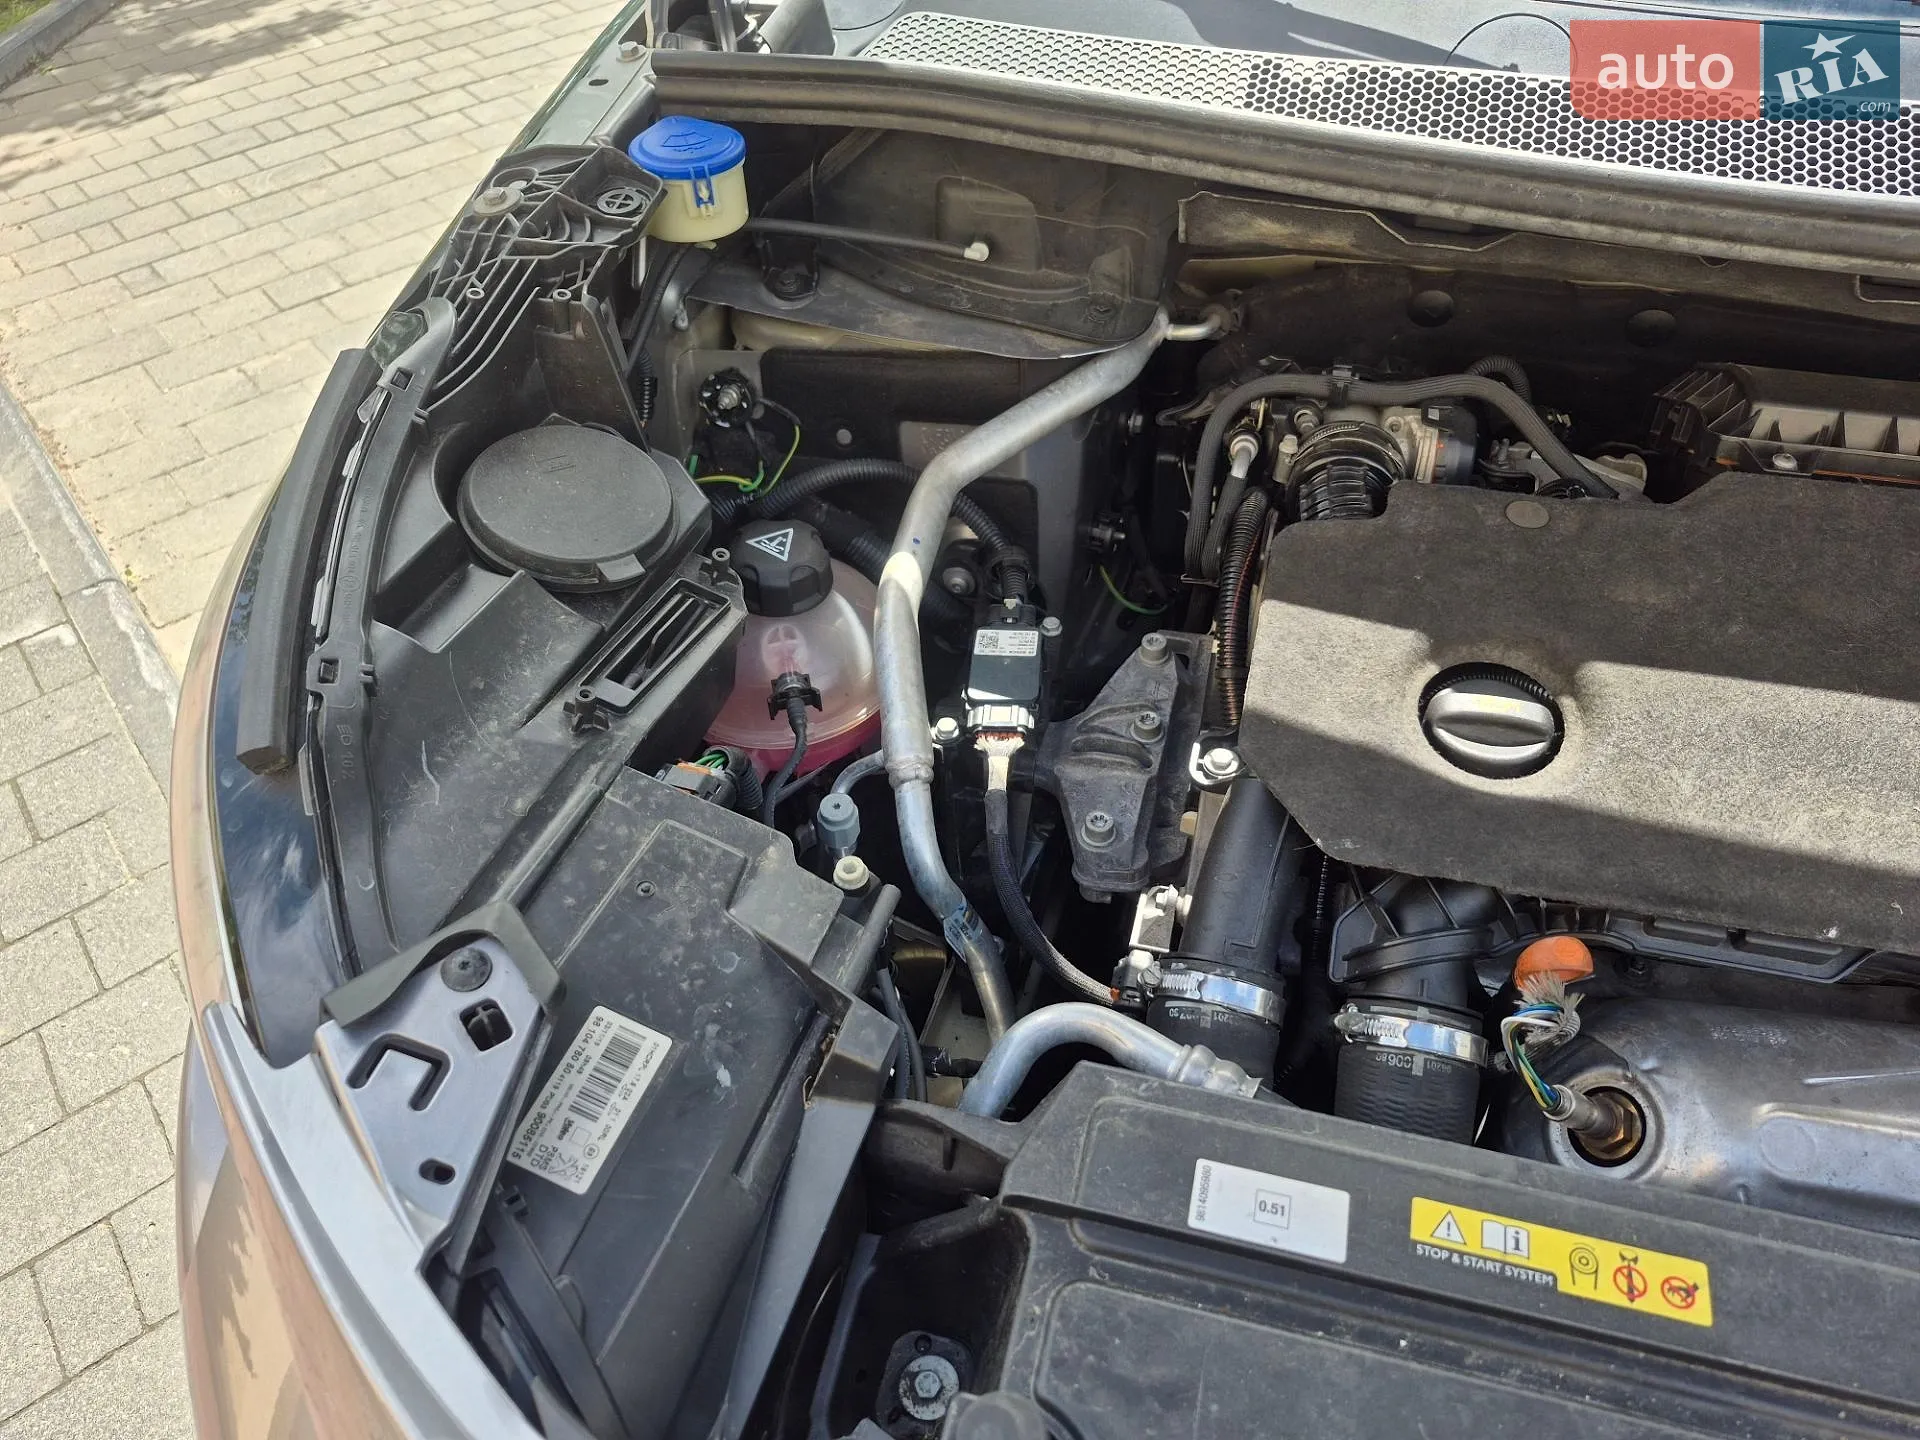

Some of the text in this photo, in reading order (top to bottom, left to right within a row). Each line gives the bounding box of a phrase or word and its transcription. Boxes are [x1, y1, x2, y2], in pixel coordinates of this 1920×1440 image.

[581, 1027, 596, 1045] 104
[1259, 1200, 1286, 1217] 0.51
[1416, 1243, 1554, 1287] STOP & START SYSTEM
